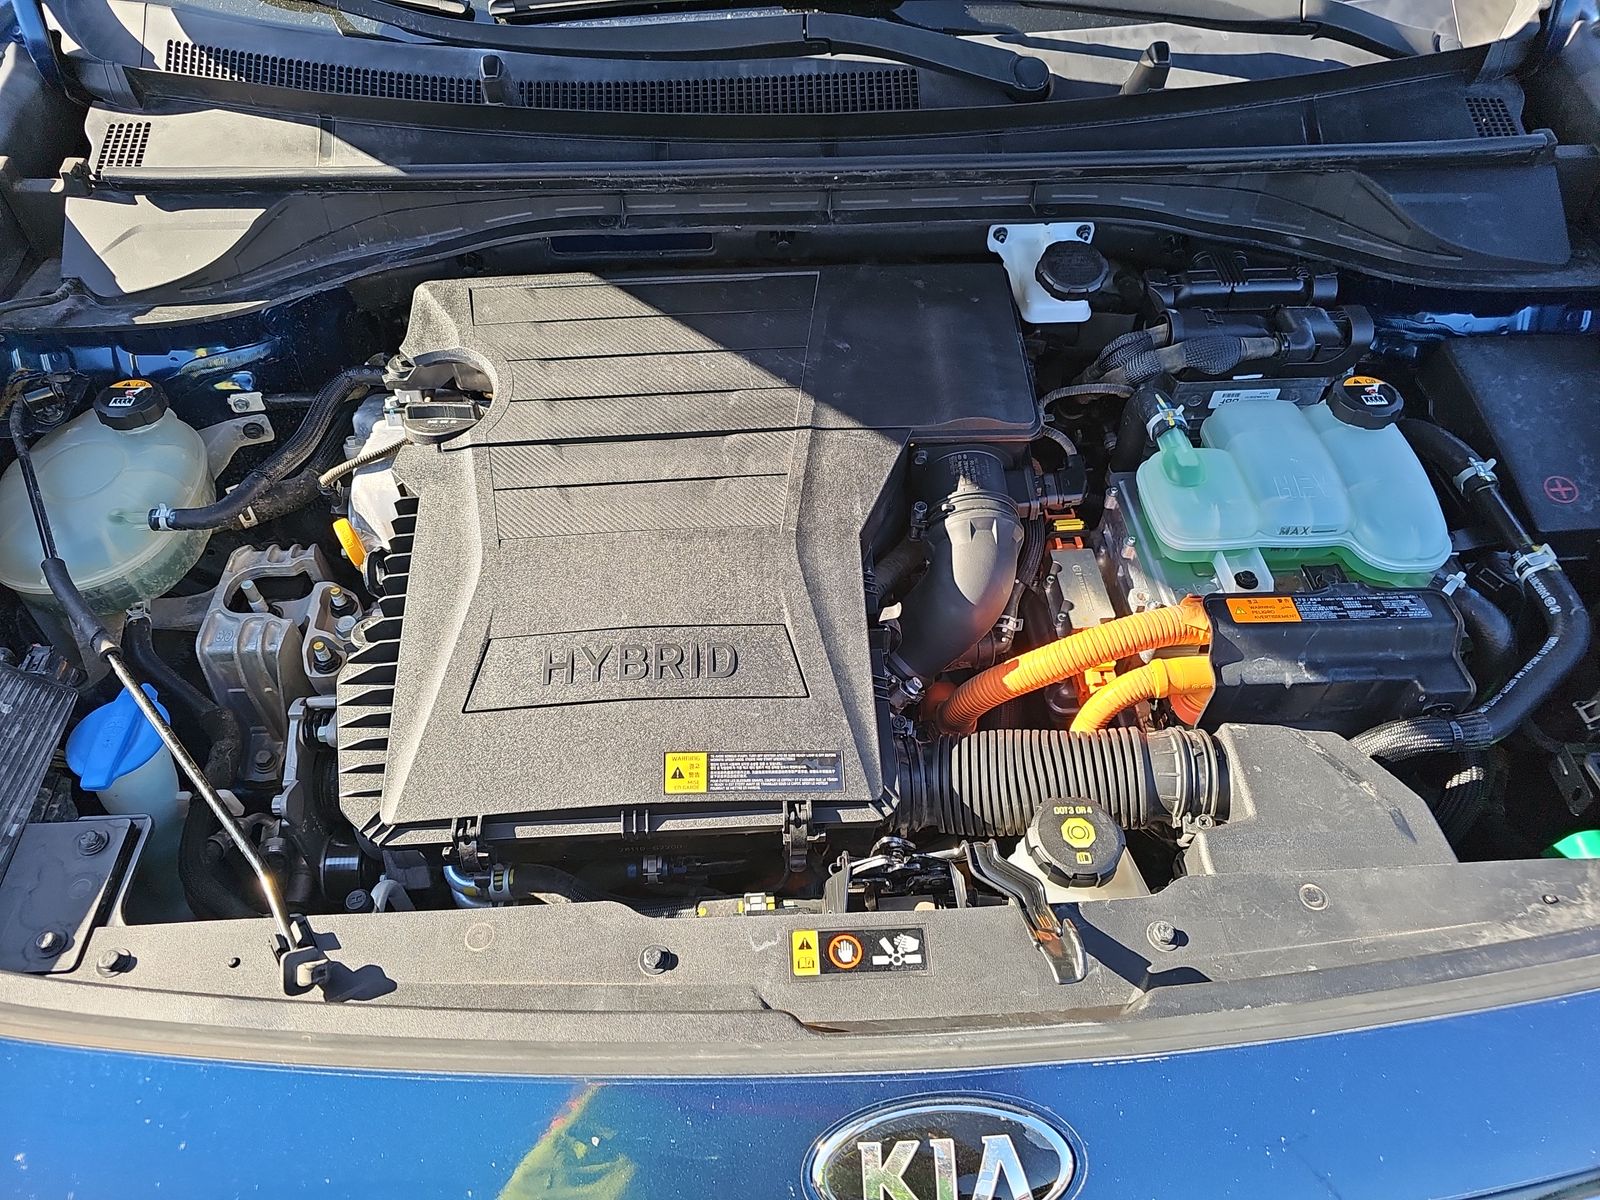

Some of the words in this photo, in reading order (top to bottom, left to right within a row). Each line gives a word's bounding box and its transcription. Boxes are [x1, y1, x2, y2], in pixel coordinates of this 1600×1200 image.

[1279, 526, 1310, 535] MAX
[542, 641, 739, 686] HYBRID
[1086, 806, 1093, 814] 4
[857, 1134, 1034, 1200] KIA
